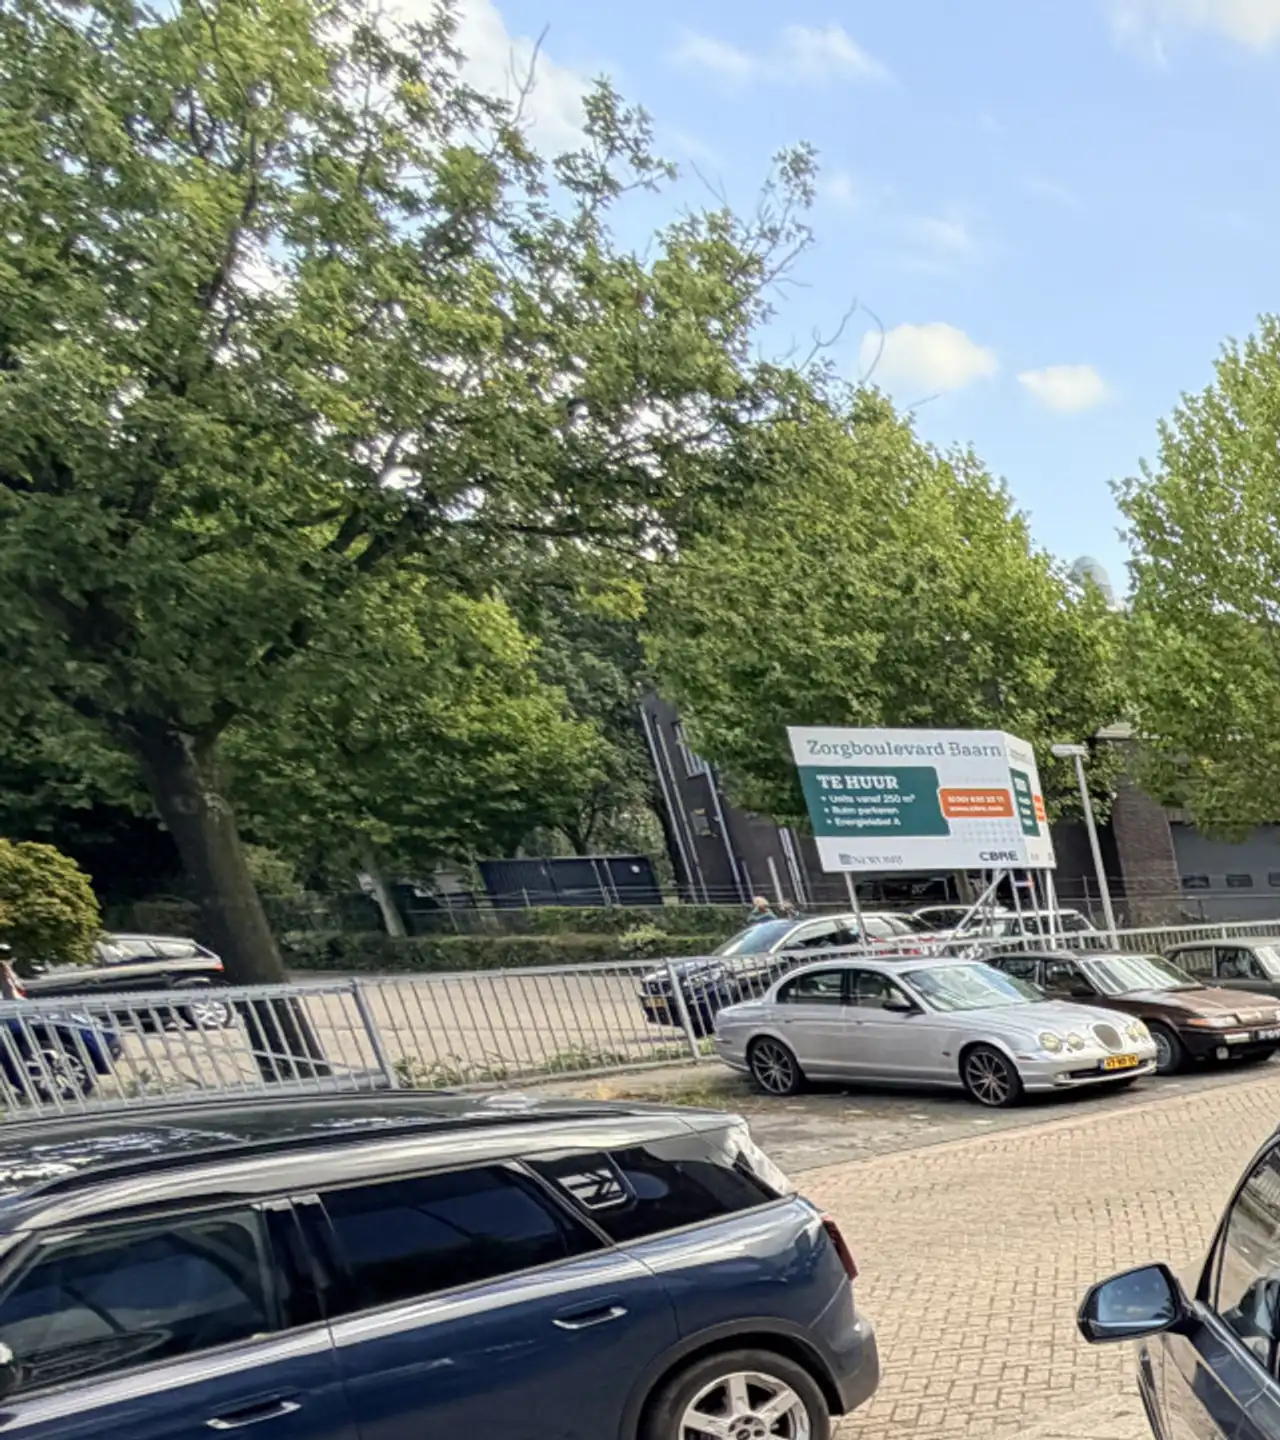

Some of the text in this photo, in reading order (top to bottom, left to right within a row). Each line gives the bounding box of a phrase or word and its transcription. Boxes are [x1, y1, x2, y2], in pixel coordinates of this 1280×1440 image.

[807, 739, 946, 760] Zorgboulevard
[948, 742, 1002, 758] Baarn
[816, 774, 900, 790] TE HUUR
[979, 851, 1019, 862] CBRE
